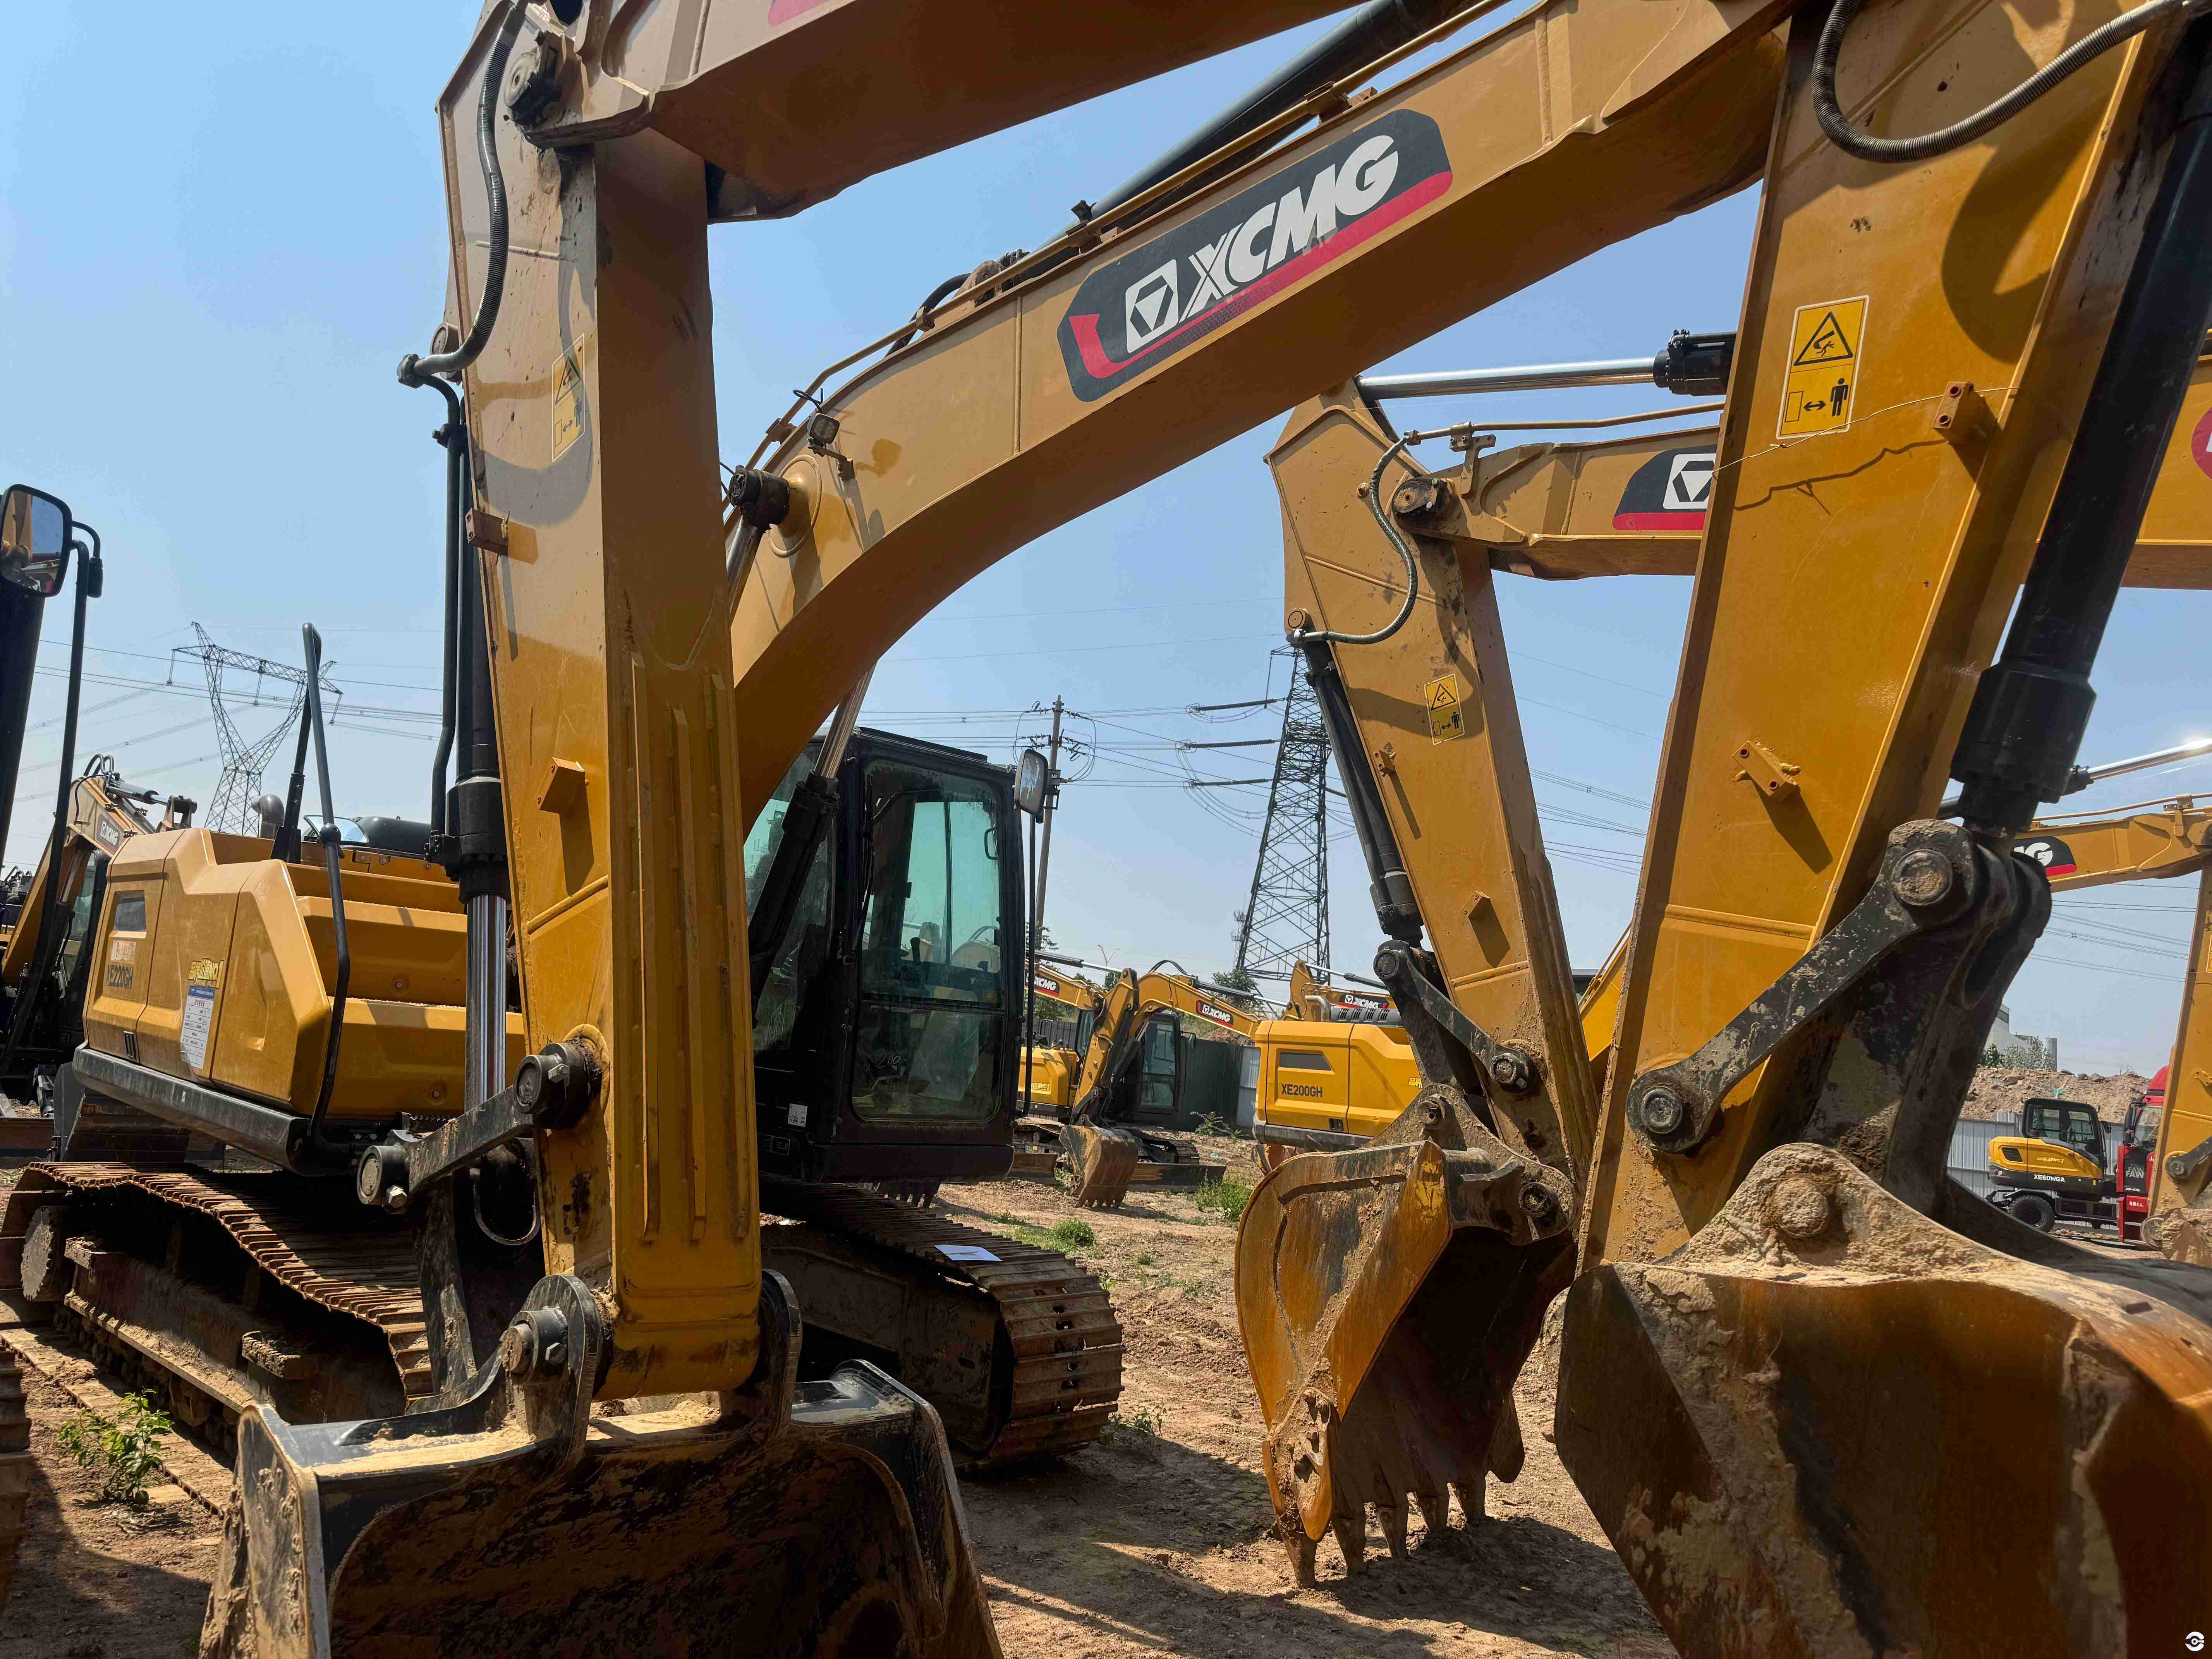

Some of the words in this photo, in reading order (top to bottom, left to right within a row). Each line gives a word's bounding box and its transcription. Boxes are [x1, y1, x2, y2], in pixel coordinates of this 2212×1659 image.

[1178, 135, 1398, 323] XCMG
[105, 825, 118, 845] XCMG
[2014, 842, 2053, 866] G
[106, 964, 134, 989] XE220GH
[1034, 976, 1056, 991] XCMG
[1353, 997, 1379, 1009] XCMG
[1209, 1008, 1230, 1022] XCMG
[1281, 1084, 1323, 1097] XE200GH
[2034, 1174, 2065, 1182] XE60WGA
